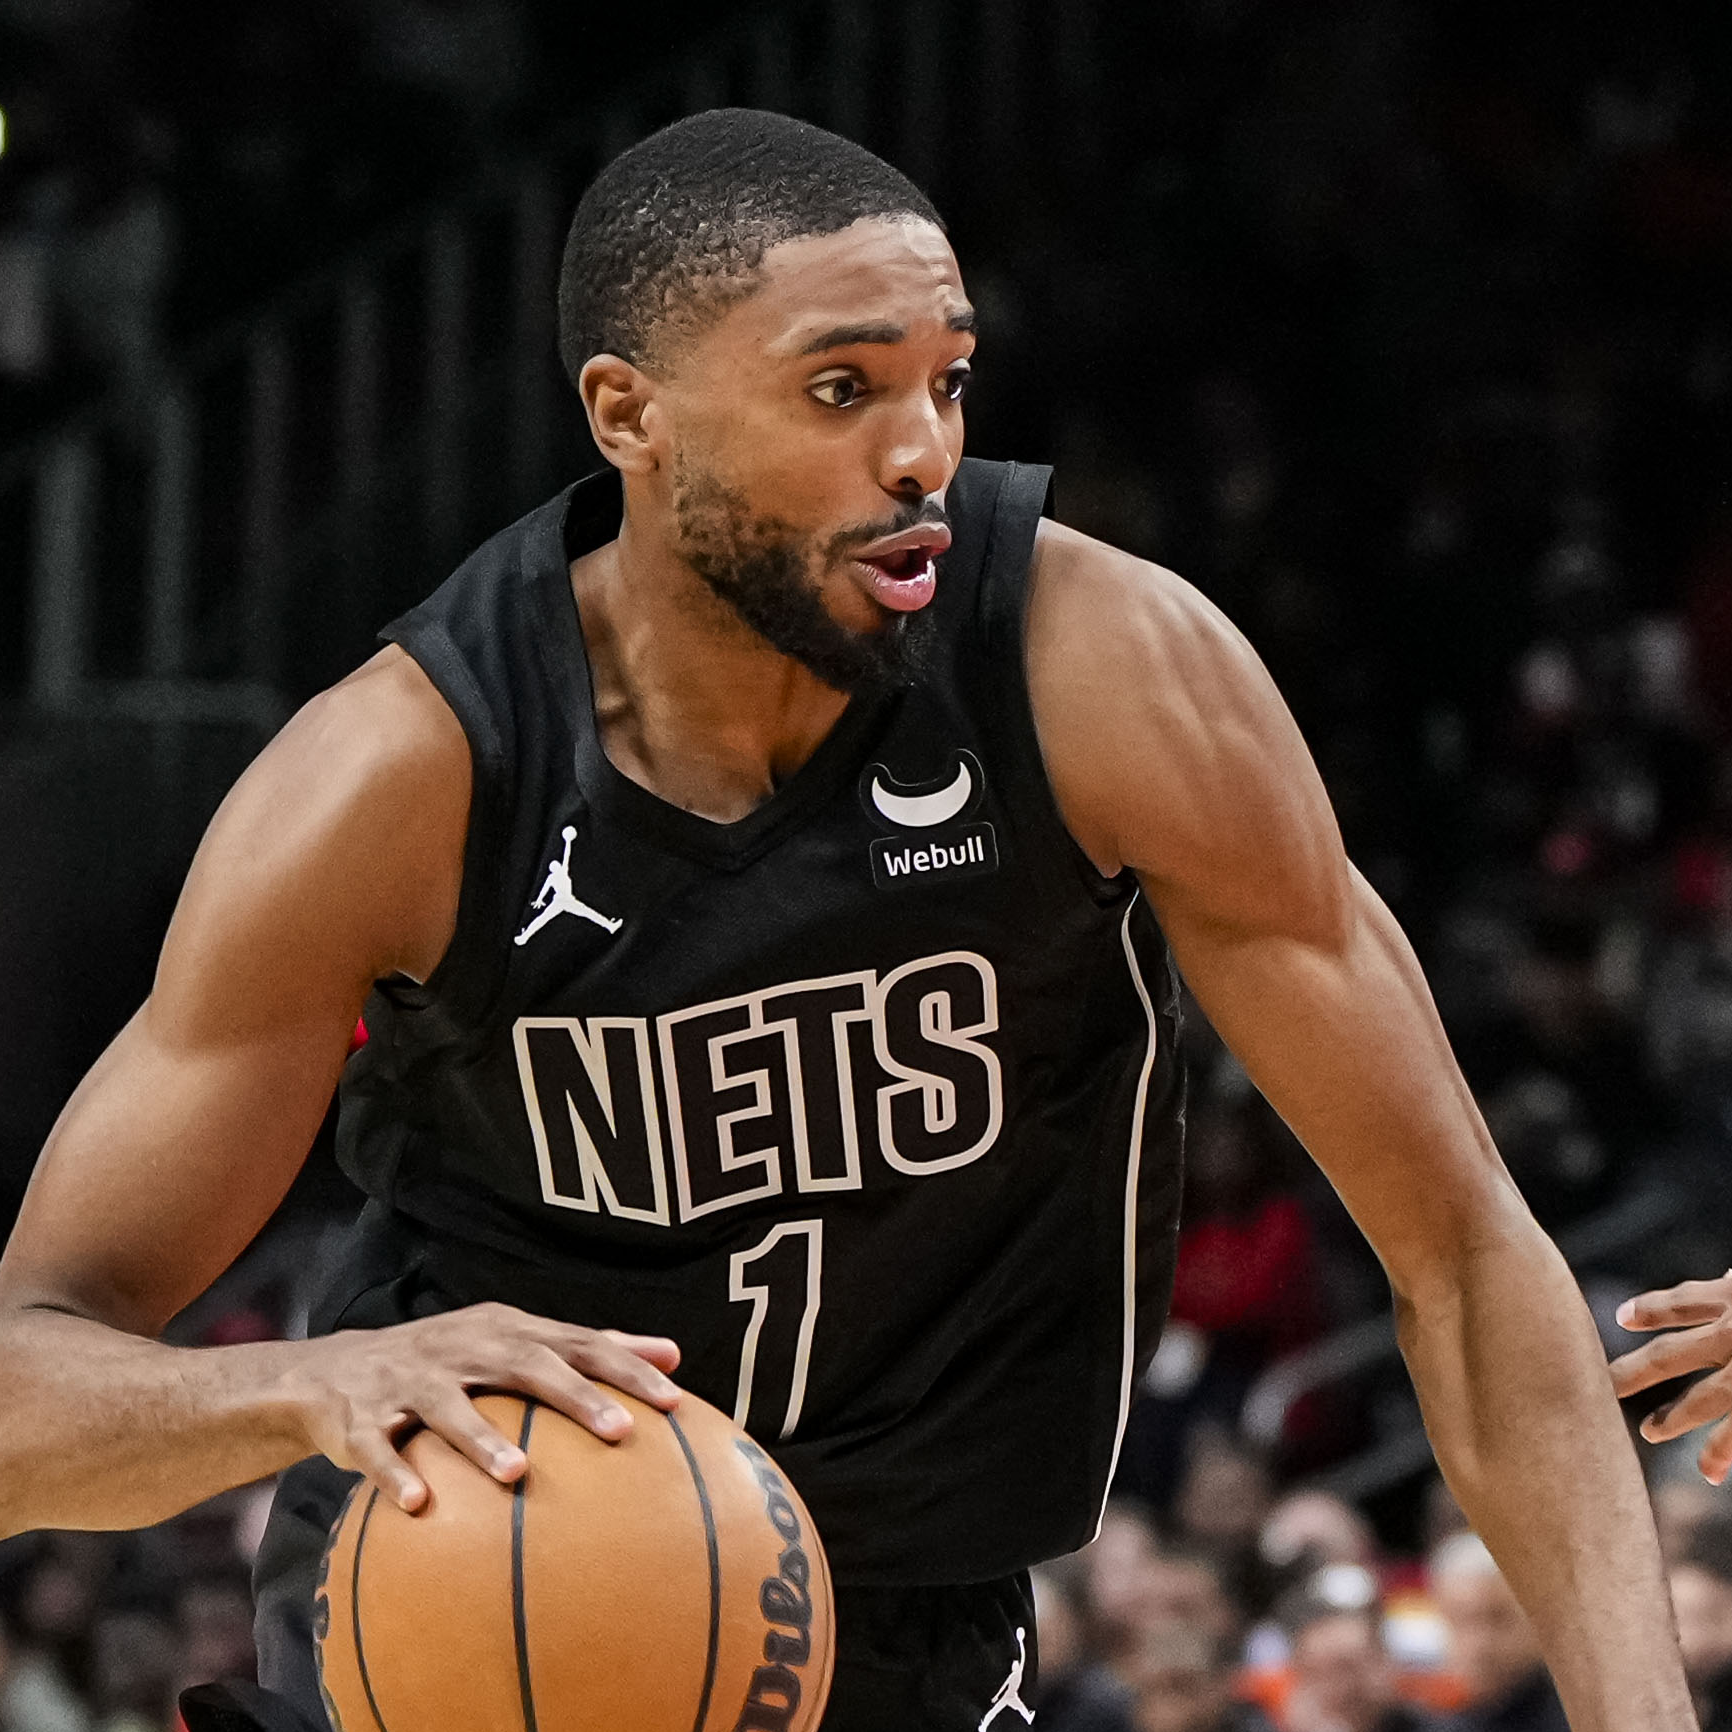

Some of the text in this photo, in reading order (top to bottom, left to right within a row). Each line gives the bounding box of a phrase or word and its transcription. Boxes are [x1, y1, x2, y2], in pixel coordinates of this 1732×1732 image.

[883, 835, 986, 877] Webull
[512, 951, 1003, 1226] NETS
[729, 1219, 823, 1440] 1
